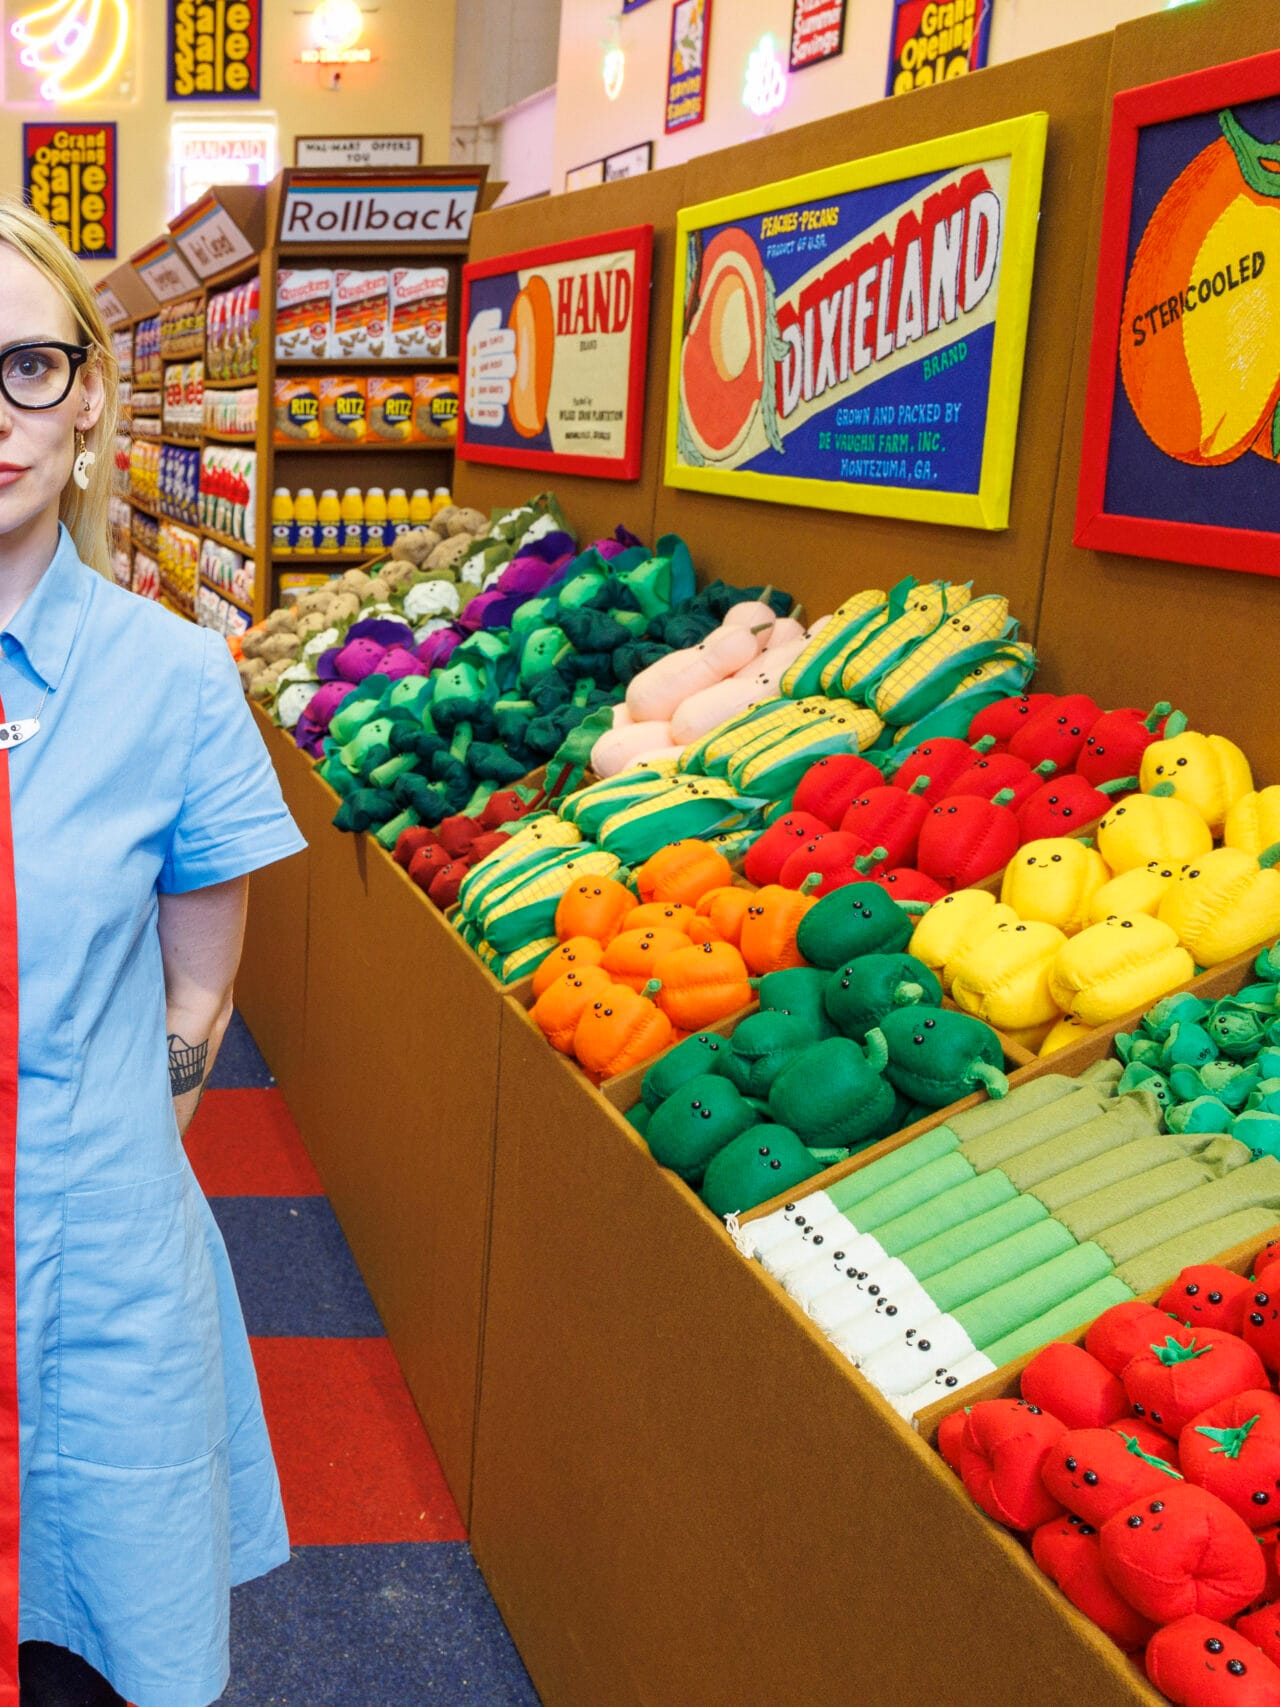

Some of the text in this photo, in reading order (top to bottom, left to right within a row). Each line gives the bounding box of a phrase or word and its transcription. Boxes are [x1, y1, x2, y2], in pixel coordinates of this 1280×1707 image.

[54, 130, 106, 149] Grand
[35, 147, 107, 166] Opening
[288, 198, 467, 233] Rollback
[556, 268, 631, 336] HAND
[780, 186, 1001, 420] DIXIELAND
[1132, 251, 1266, 347] STERICOOLED
[922, 341, 968, 382] BRAND
[290, 398, 318, 415] RITZ
[336, 397, 365, 414] RITZ
[385, 398, 412, 416] RITZ
[835, 402, 962, 427] GROWN AND PACKED BY
[818, 432, 832, 450] DE
[834, 432, 876, 452] VAUGHN
